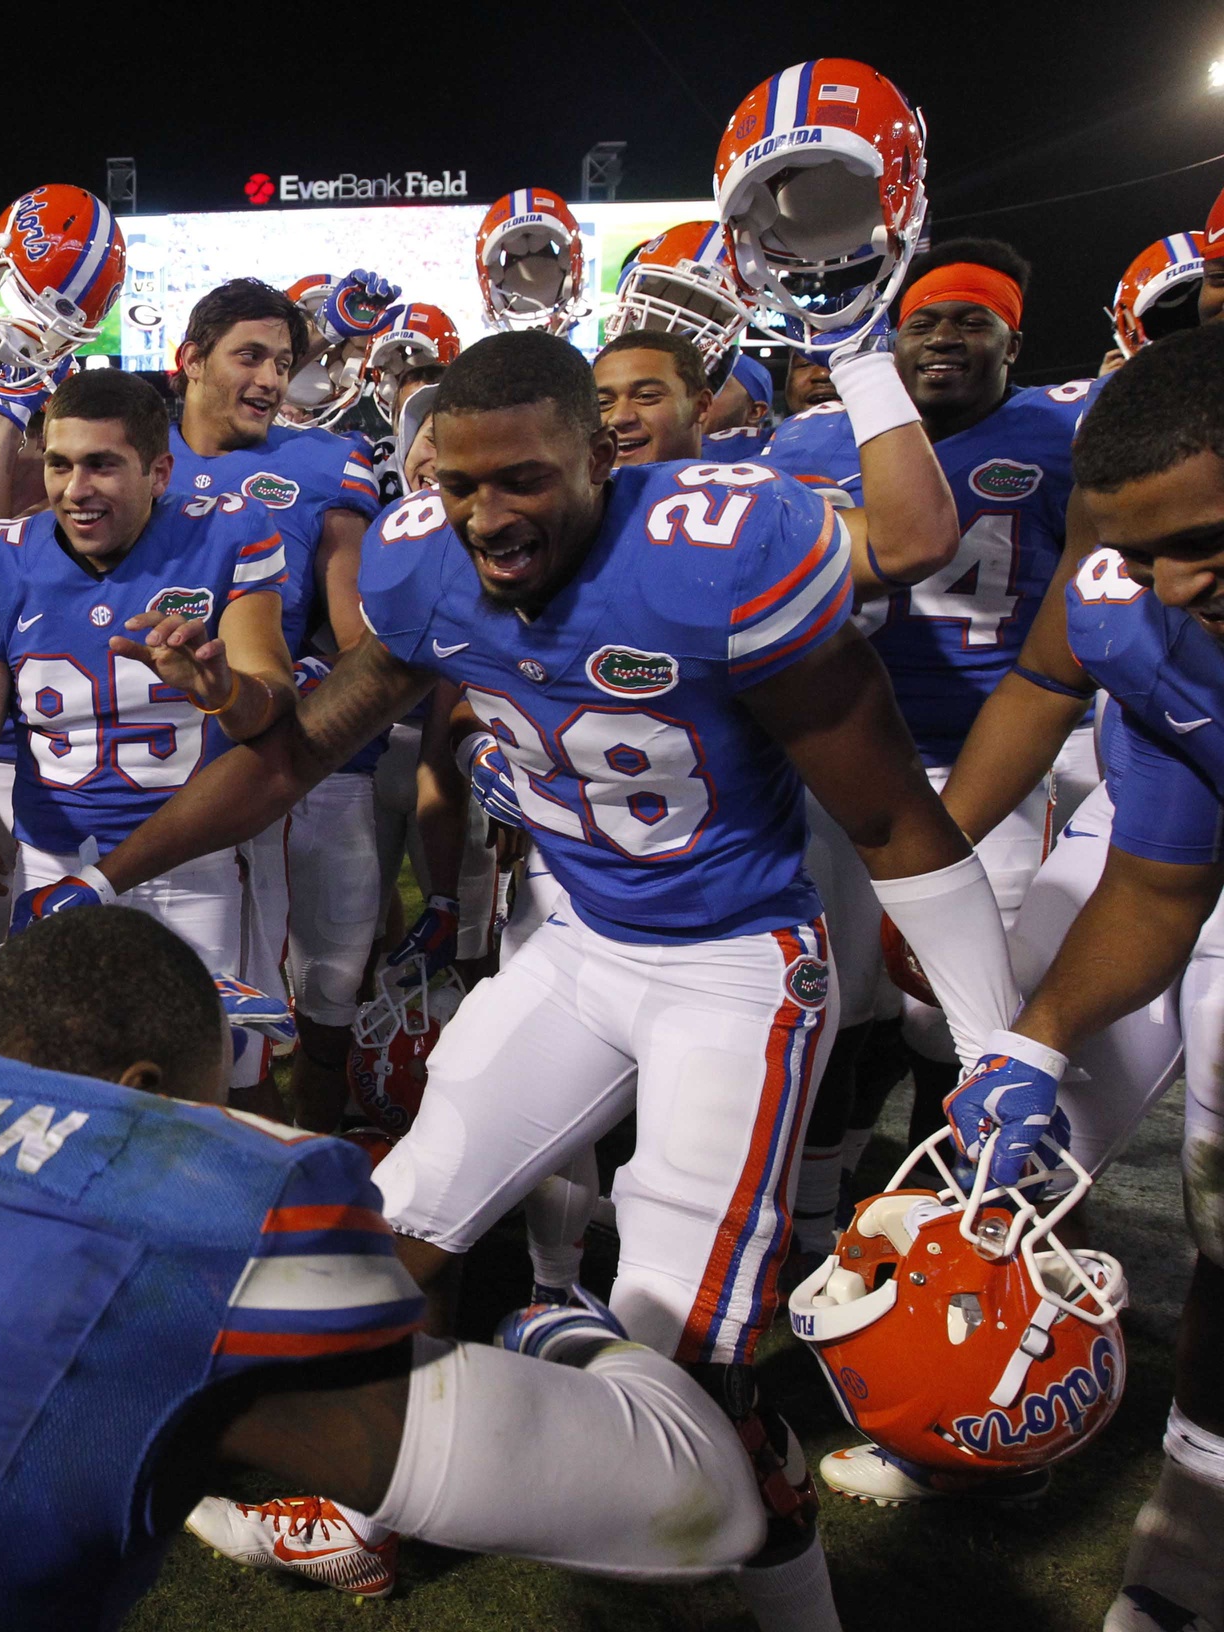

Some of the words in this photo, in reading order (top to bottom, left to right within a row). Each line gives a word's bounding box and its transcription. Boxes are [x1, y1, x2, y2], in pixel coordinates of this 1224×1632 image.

[736, 114, 757, 139] SEC
[745, 128, 822, 168] FLORIDA
[279, 172, 402, 200] EverBank
[404, 170, 468, 197] Field
[502, 213, 543, 232] FLORIDA
[1165, 260, 1204, 281] FLORI
[128, 304, 162, 327] G
[381, 331, 415, 344] FLORIDA
[195, 474, 212, 489] SEC
[380, 484, 448, 544] 8
[646, 462, 781, 549] 28
[90, 606, 113, 627] SEC
[16, 652, 210, 793] 95
[459, 681, 718, 862] 28
[952, 1335, 1120, 1454] Gators
